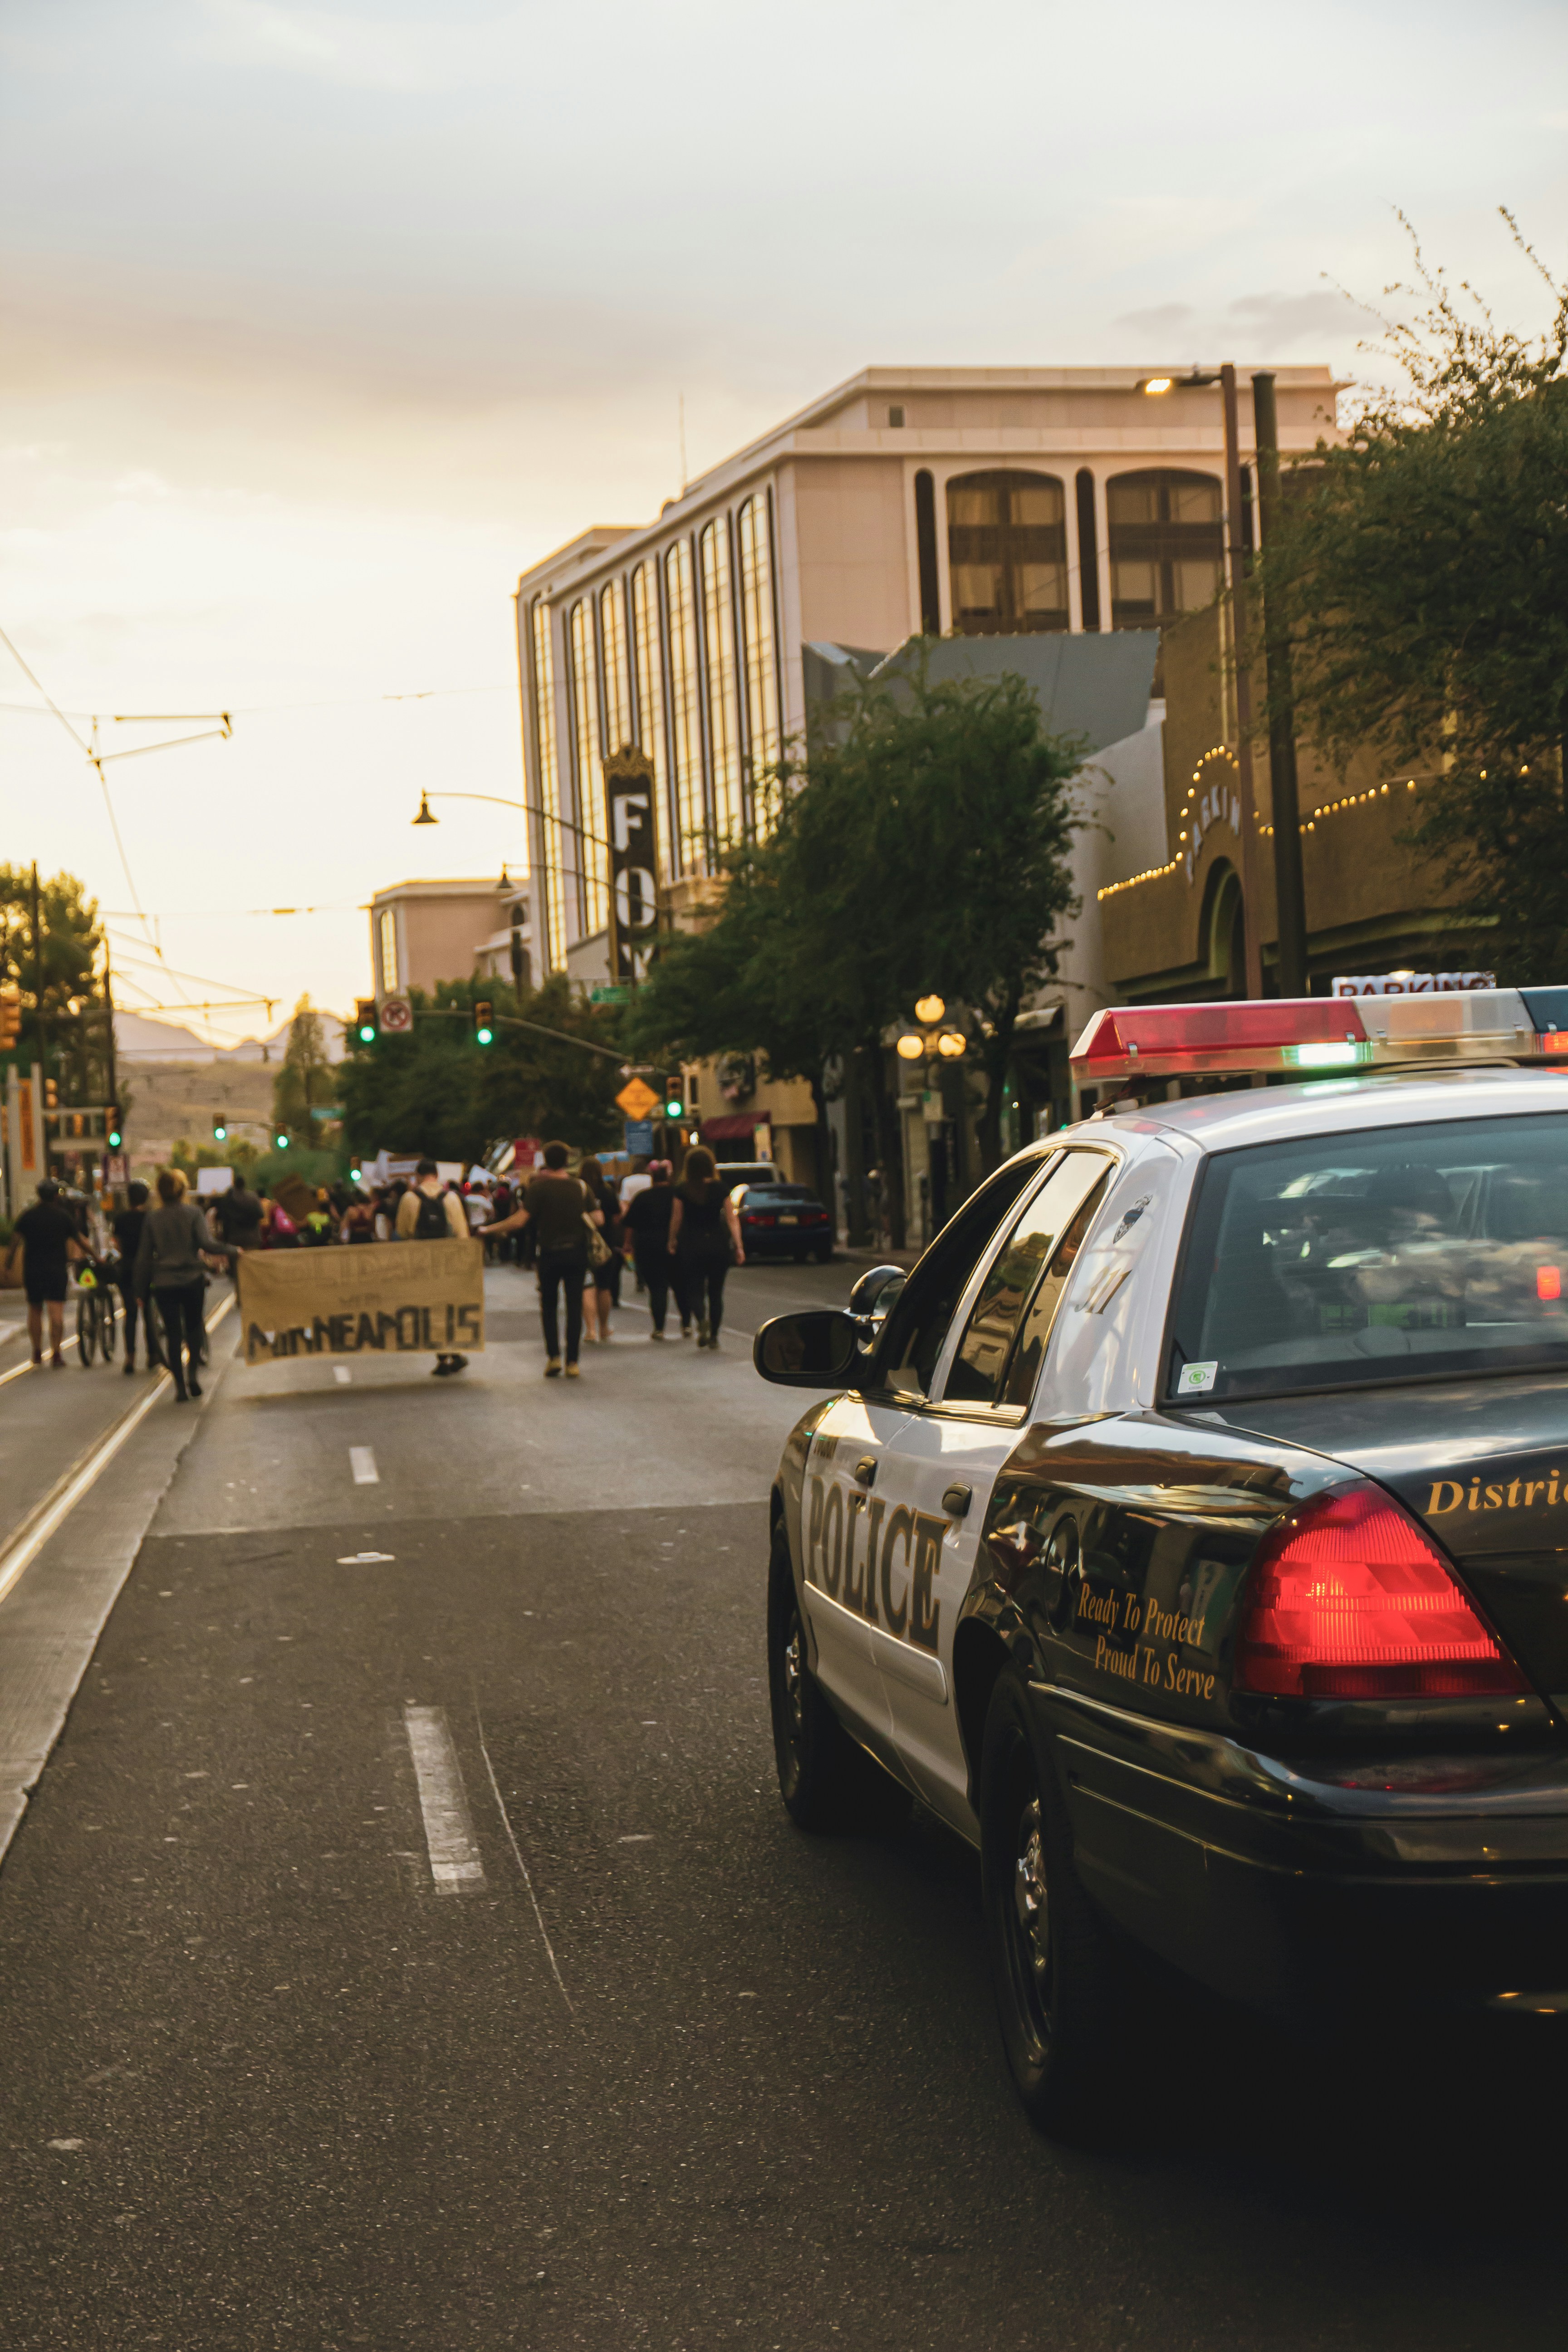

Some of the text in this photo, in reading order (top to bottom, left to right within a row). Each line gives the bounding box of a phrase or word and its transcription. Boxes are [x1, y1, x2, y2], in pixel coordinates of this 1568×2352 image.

[1423, 1469, 1568, 1515] Distri
[808, 1475, 954, 1656] POLICE
[1077, 1582, 1205, 1646] Ready To Protect
[1095, 1634, 1215, 1700] Proud To Serve
